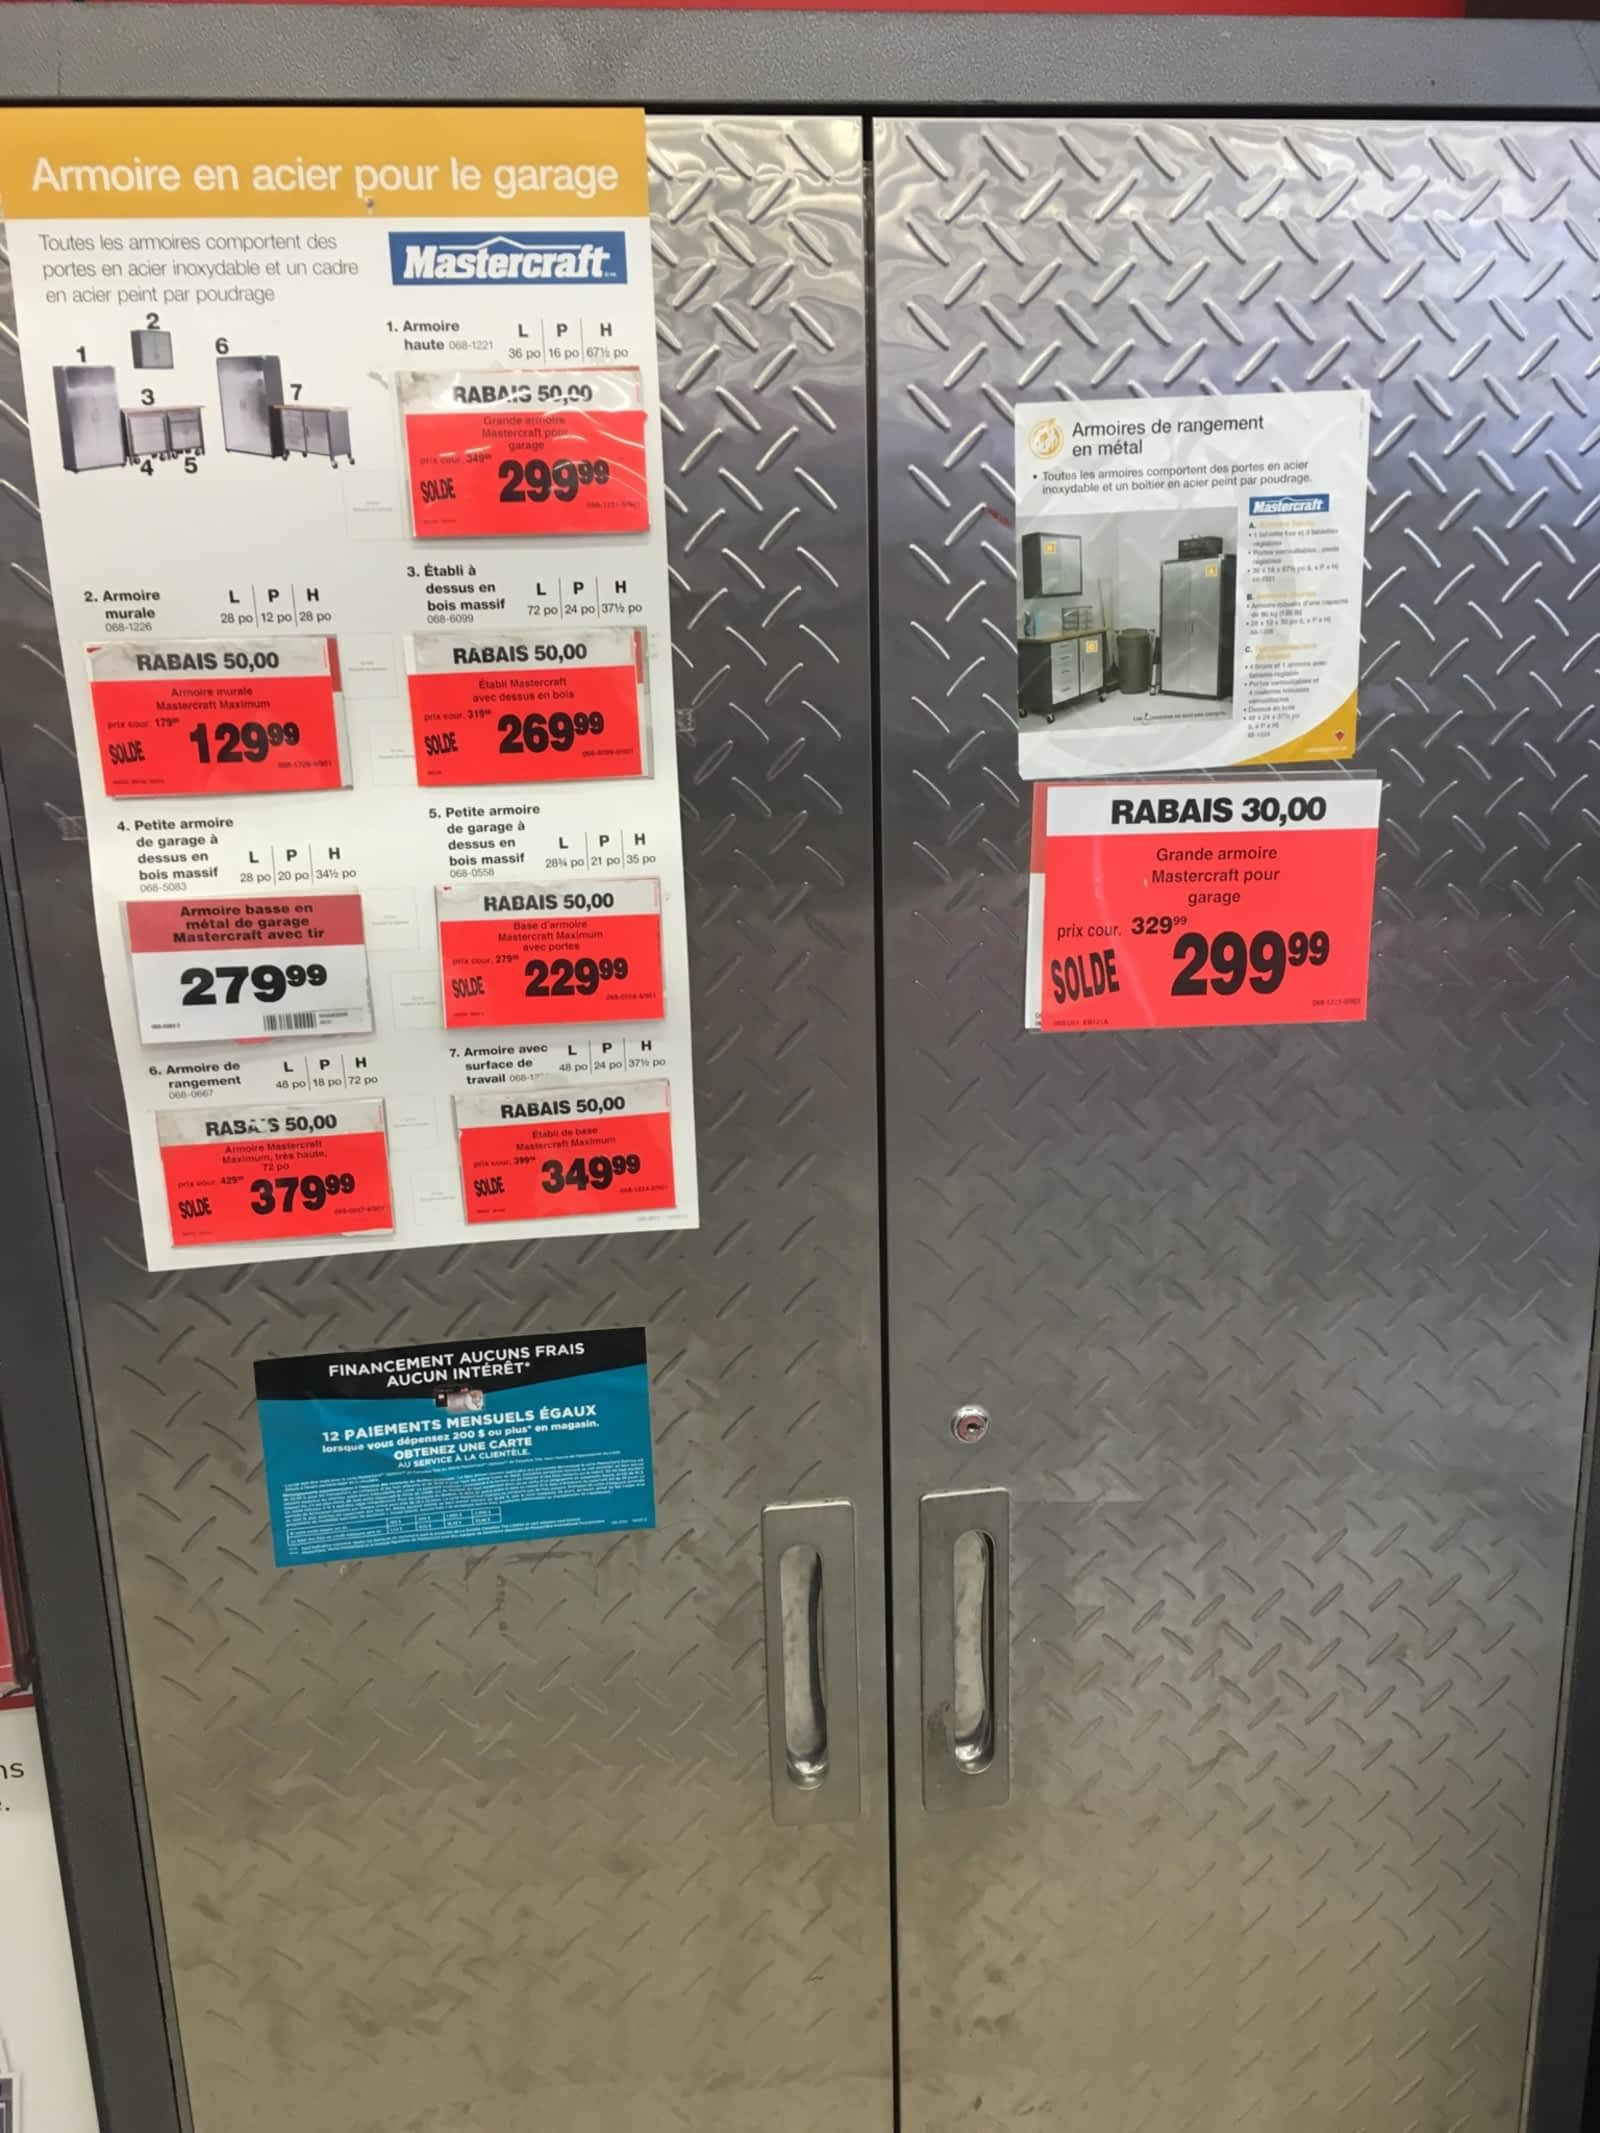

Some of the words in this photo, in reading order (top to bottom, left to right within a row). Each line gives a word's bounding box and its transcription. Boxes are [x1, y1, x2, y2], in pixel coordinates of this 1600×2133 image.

[32, 157, 181, 191] Armoire
[194, 164, 239, 190] en
[252, 156, 341, 191] acier
[354, 163, 438, 198] pour
[450, 156, 480, 190] le
[494, 164, 618, 199] garage
[39, 234, 94, 250] Toutes
[100, 235, 123, 250] les
[129, 234, 200, 249] armoires
[206, 234, 301, 252] comportent
[307, 234, 336, 249] des
[43, 261, 96, 280] portes
[102, 262, 122, 277] en
[128, 260, 166, 277] acier
[173, 259, 259, 279] inoxydable
[265, 260, 280, 275] et
[287, 260, 306, 275] un
[313, 259, 359, 275] cadre
[403, 244, 610, 279] Mastercraft
[46, 288, 66, 303] en
[73, 286, 110, 302] acier
[118, 285, 156, 305] peint
[164, 288, 189, 304] par
[197, 285, 275, 304] poudrage
[146, 313, 160, 329] 2
[387, 321, 398, 332] 1.
[403, 321, 459, 332] Armoire
[215, 338, 229, 354] 6
[404, 340, 444, 350] haute
[449, 340, 493, 350] 068-1221
[76, 346, 86, 362] 1
[141, 389, 154, 405] 3
[290, 384, 302, 400] 7
[538, 385, 592, 405] 50,00
[1072, 422, 1146, 437] Armoires
[1151, 419, 1172, 434] de
[1177, 416, 1264, 435] rangement
[1073, 444, 1091, 456] en
[1098, 440, 1143, 456] métal
[140, 459, 153, 476] 4
[184, 457, 197, 474] 5
[1043, 471, 1077, 481] Toutes
[1080, 470, 1095, 480] les
[1098, 467, 1144, 479] armoires
[1147, 465, 1207, 478] comportent
[1210, 464, 1229, 474] des
[1232, 462, 1264, 474] portes
[1268, 462, 1280, 471] en
[1283, 460, 1308, 470] acier
[420, 479, 455, 503] SOLDE
[1042, 483, 1099, 495] inoxydable
[1103, 483, 1113, 492] et
[1116, 482, 1128, 490] un
[1132, 479, 1164, 489] boîtier
[1168, 480, 1180, 488] en
[1183, 478, 1208, 488] acier
[1211, 477, 1238, 488] peint
[1240, 477, 1256, 487] par
[1260, 473, 1312, 486] poudrage.
[1252, 499, 1323, 515] Mastercraft
[407, 567, 420, 578] 3.
[425, 564, 464, 577] Établi
[469, 564, 476, 576] à
[84, 591, 97, 602] 2.
[103, 590, 160, 602] Armoire
[105, 608, 155, 619] murale
[427, 614, 474, 624] 068-6099
[105, 622, 152, 632] 068-1226
[137, 652, 217, 671] RABAIS
[224, 652, 279, 672] 50,00
[453, 646, 528, 665] RABAIS
[535, 644, 587, 662] 50,00
[109, 741, 145, 765] SOLDE
[425, 732, 458, 757] SOLDE
[429, 809, 441, 819] 5.
[446, 807, 485, 818] Petite
[489, 805, 540, 816] armoire
[1112, 798, 1232, 824] RABAIS
[1242, 797, 1326, 827] 30,00
[117, 821, 130, 832] 4.
[134, 819, 175, 831] Petite
[180, 818, 234, 829] armoire
[1156, 847, 1213, 862] Grande
[1217, 846, 1277, 860] armoire
[1152, 868, 1239, 883] Mastercraft
[1243, 870, 1280, 883] pour
[484, 895, 557, 912] RABAIS
[563, 893, 614, 912] 50,00
[1188, 891, 1240, 906] garage
[181, 906, 240, 917] Armoire
[245, 904, 289, 915] basse
[295, 903, 313, 913] en
[173, 929, 262, 943] Mastercraft
[268, 930, 302, 940] avec
[308, 929, 324, 939] tir
[1058, 924, 1083, 940] prix
[1088, 924, 1121, 937] cour.
[1051, 949, 1120, 1004] SOLDE
[452, 976, 485, 998] SOLDE
[450, 1049, 460, 1058] 7.
[464, 1046, 515, 1057] Armoire
[519, 1045, 548, 1053] avec
[149, 1064, 162, 1075] 6.
[166, 1063, 219, 1074] Armoire
[224, 1061, 240, 1071] de
[466, 1060, 514, 1071] surface
[518, 1059, 532, 1068] de
[169, 1076, 241, 1089] rangement
[467, 1074, 505, 1085] travail
[500, 1101, 570, 1119] RABAIS
[577, 1097, 625, 1116] 50,00
[285, 1115, 337, 1133] 50,00
[474, 1177, 504, 1197] SOLDE
[179, 1197, 212, 1219] SOLDE
[329, 1354, 453, 1377] FINANCEMENT
[460, 1347, 530, 1366] AUCUNS
[536, 1343, 584, 1359] FRAIS
[387, 1372, 448, 1388] AUCUN
[323, 1432, 339, 1442] 12
[345, 1420, 441, 1440] PAIEMENTS
[447, 1412, 535, 1428] MENSUELS
[540, 1404, 596, 1421] ÉGAUX
[323, 1443, 364, 1453] lorsque
[368, 1440, 394, 1449] vous
[397, 1433, 449, 1447] dépensez
[453, 1431, 475, 1439] 200
[478, 1429, 485, 1439] $
[551, 1420, 599, 1433] magasin.
[394, 1445, 454, 1460] OBTENEZ
[459, 1442, 485, 1452] UNE
[490, 1437, 532, 1449] CARTE
[397, 1460, 410, 1468] AU
[413, 1456, 453, 1466] SERVICE
[456, 1452, 463, 1462] À
[465, 1453, 476, 1461] LA
[479, 1448, 530, 1460] CLIENTÈLE.
